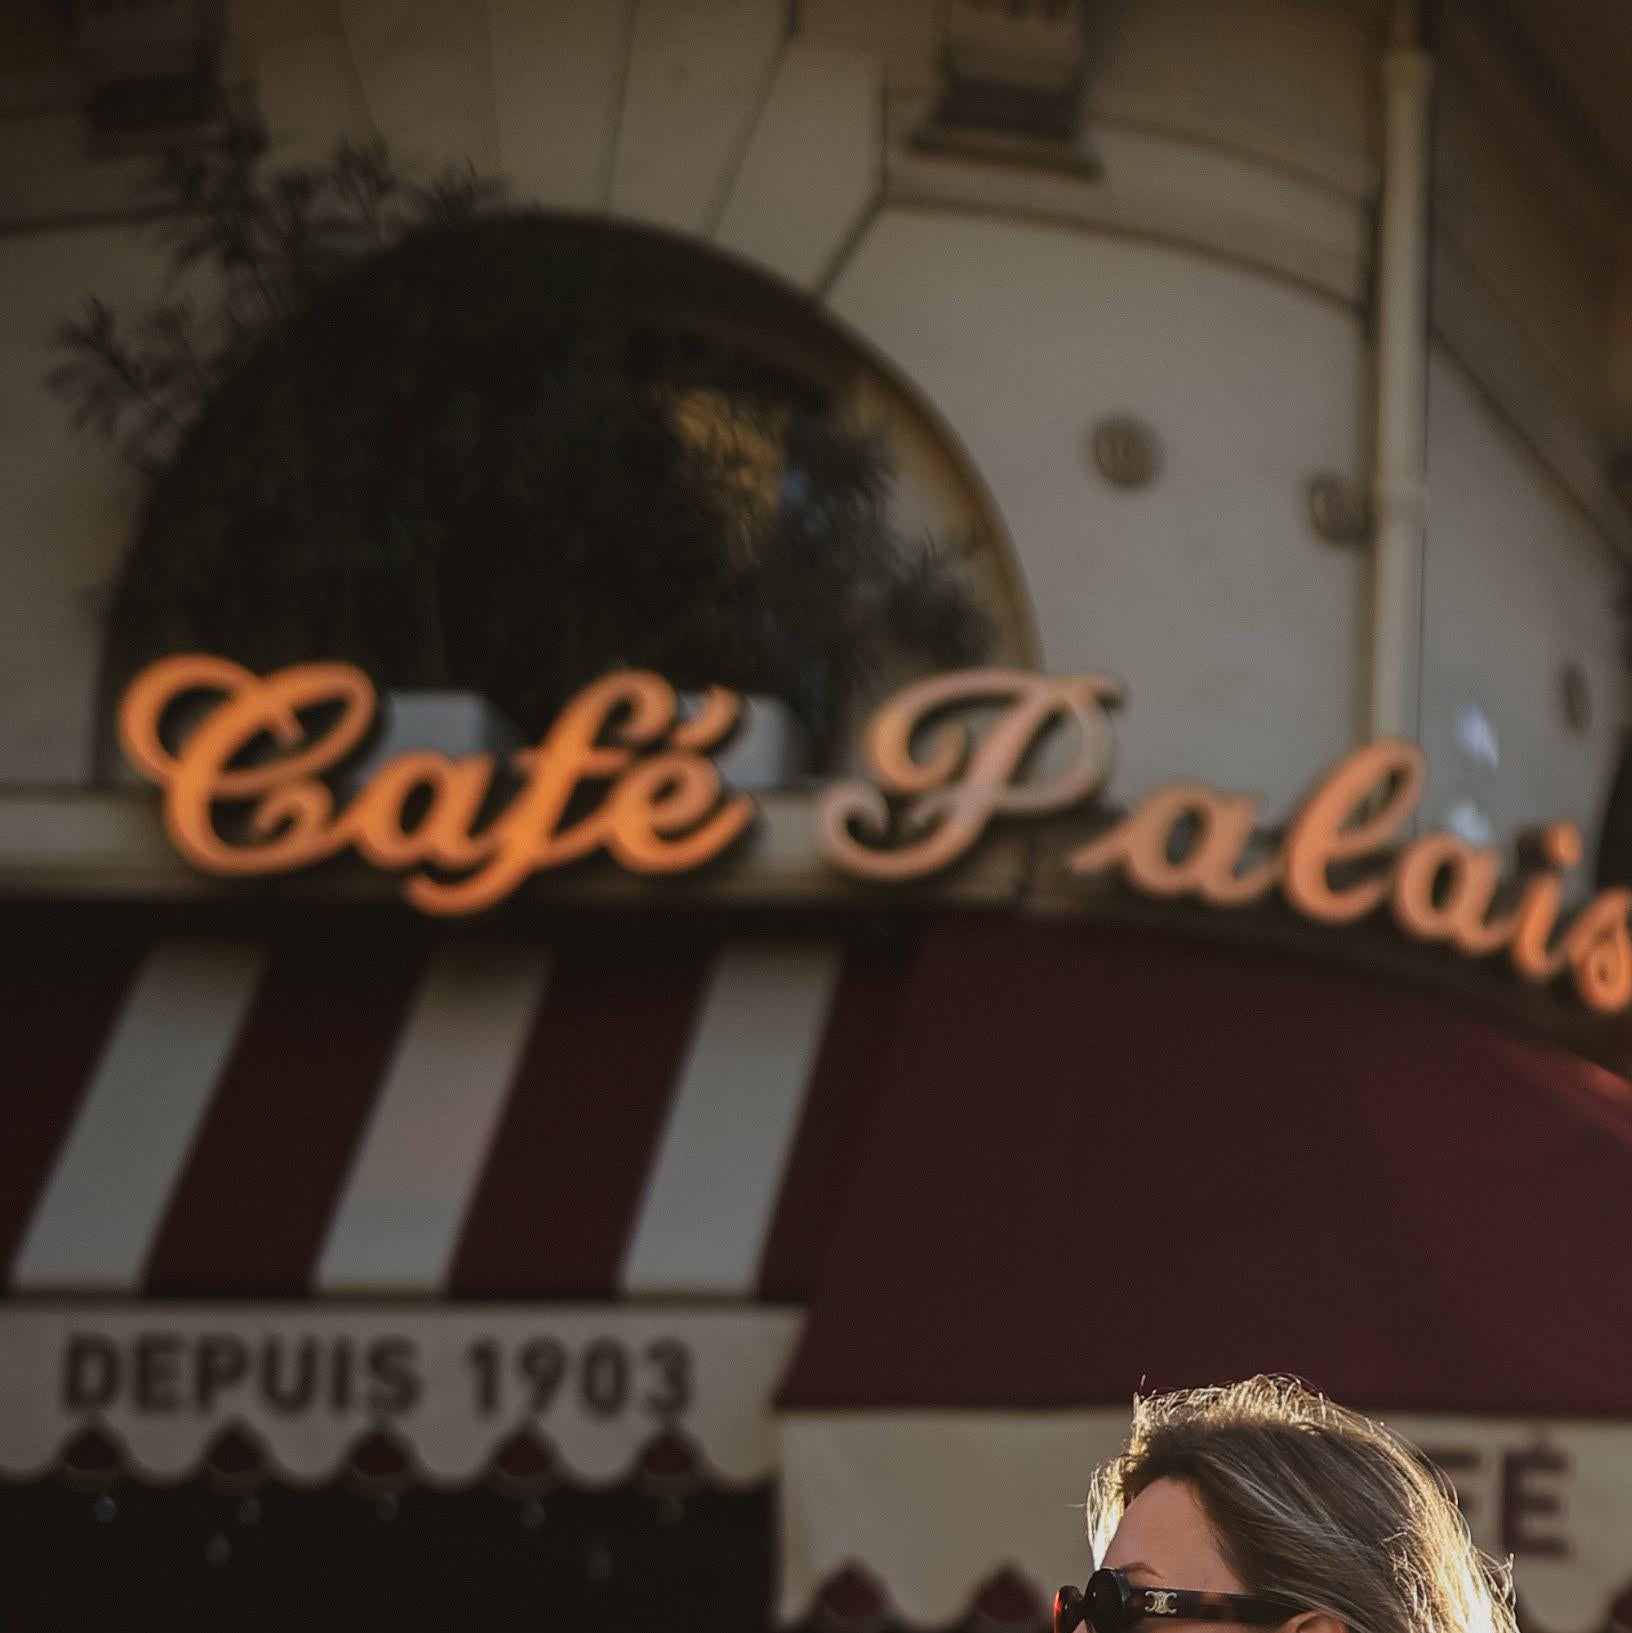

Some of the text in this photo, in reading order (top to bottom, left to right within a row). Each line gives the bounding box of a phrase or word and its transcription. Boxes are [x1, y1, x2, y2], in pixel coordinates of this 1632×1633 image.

[117, 652, 756, 917] Café
[61, 1331, 695, 1418] DEPUIS 1903
